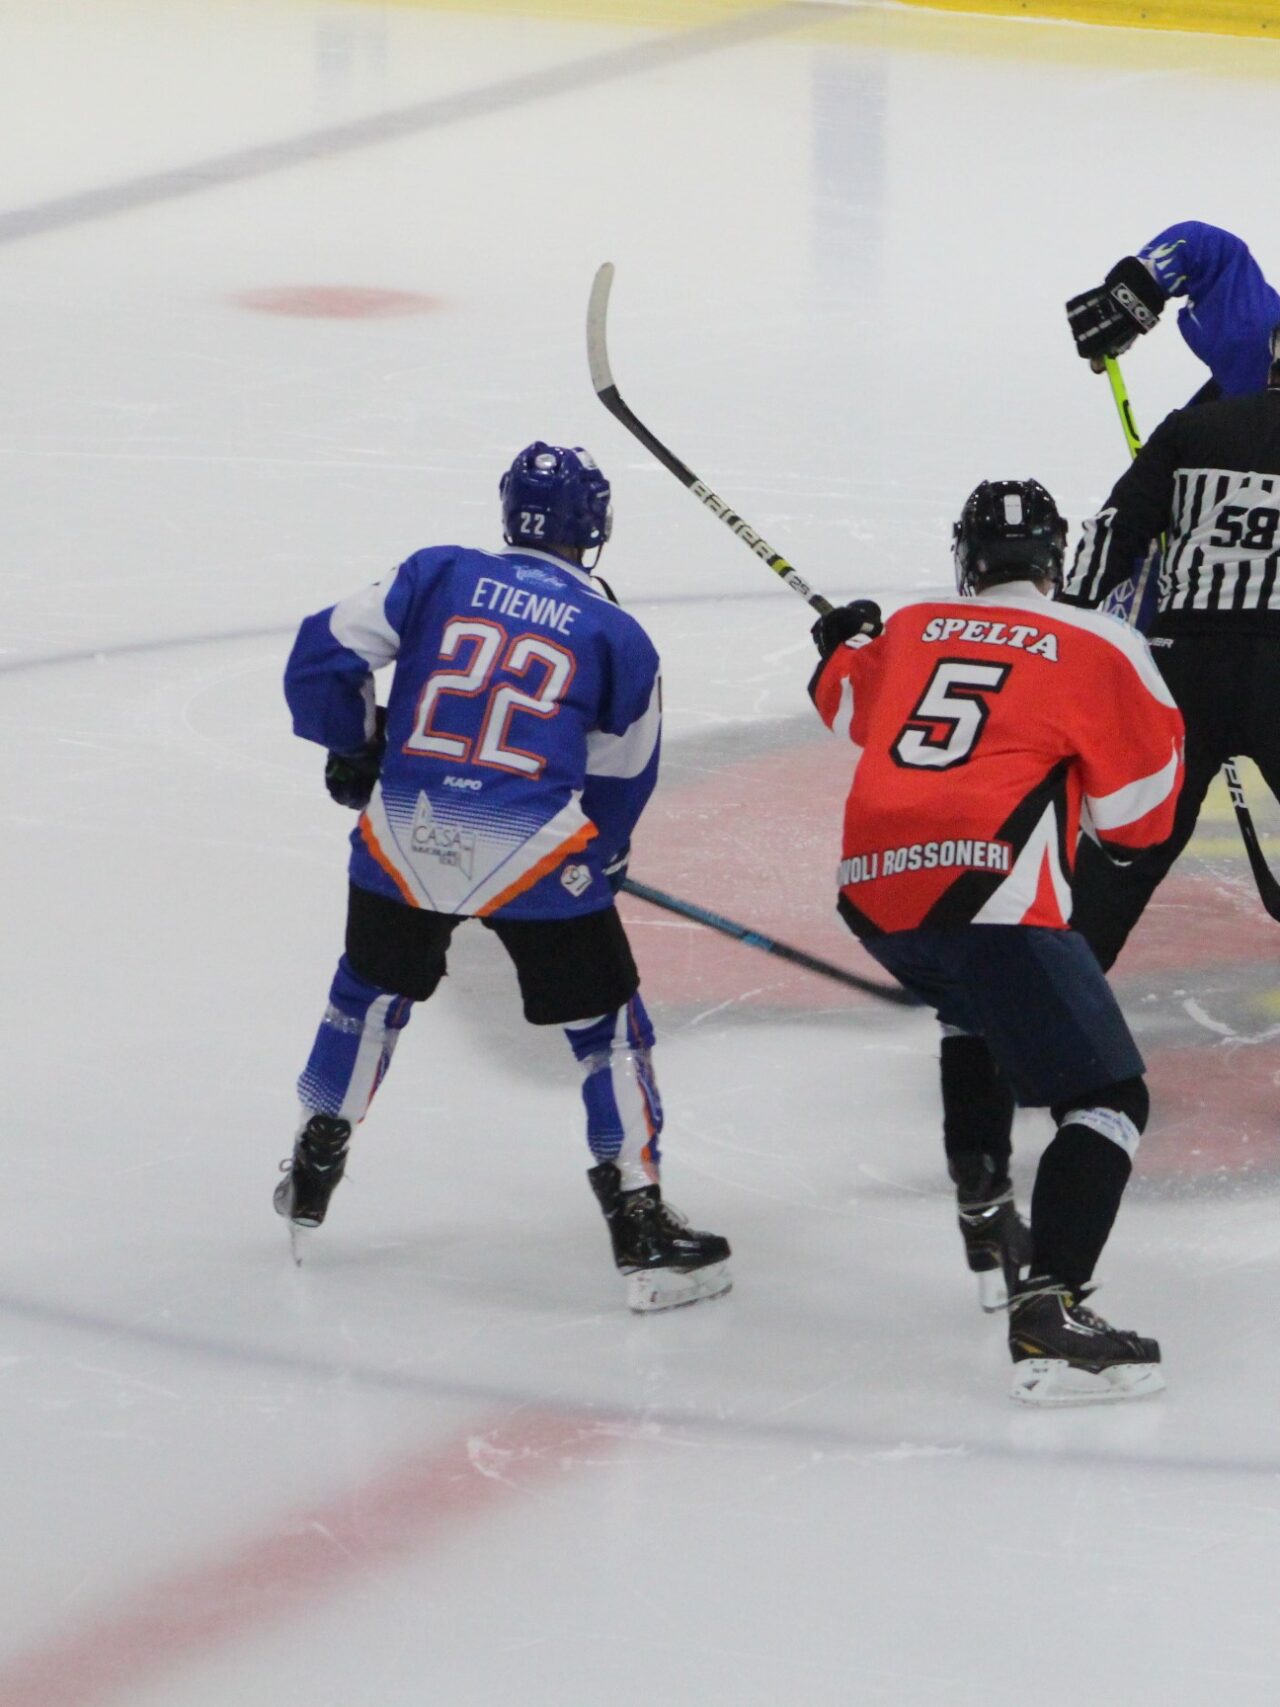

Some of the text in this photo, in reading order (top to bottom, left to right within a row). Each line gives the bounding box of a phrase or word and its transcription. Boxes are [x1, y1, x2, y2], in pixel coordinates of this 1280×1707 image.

[520, 511, 546, 536] 22
[689, 478, 774, 563] BAUER
[1210, 505, 1280, 550] 58
[471, 577, 582, 636] ETIENNE
[921, 617, 1059, 663] SPELTA
[403, 615, 577, 780] 22
[890, 656, 1013, 772] 5
[443, 776, 483, 791] KAPO
[414, 825, 463, 849] CASA
[883, 839, 1010, 877] ROSSONERI
[563, 867, 593, 892] 97
